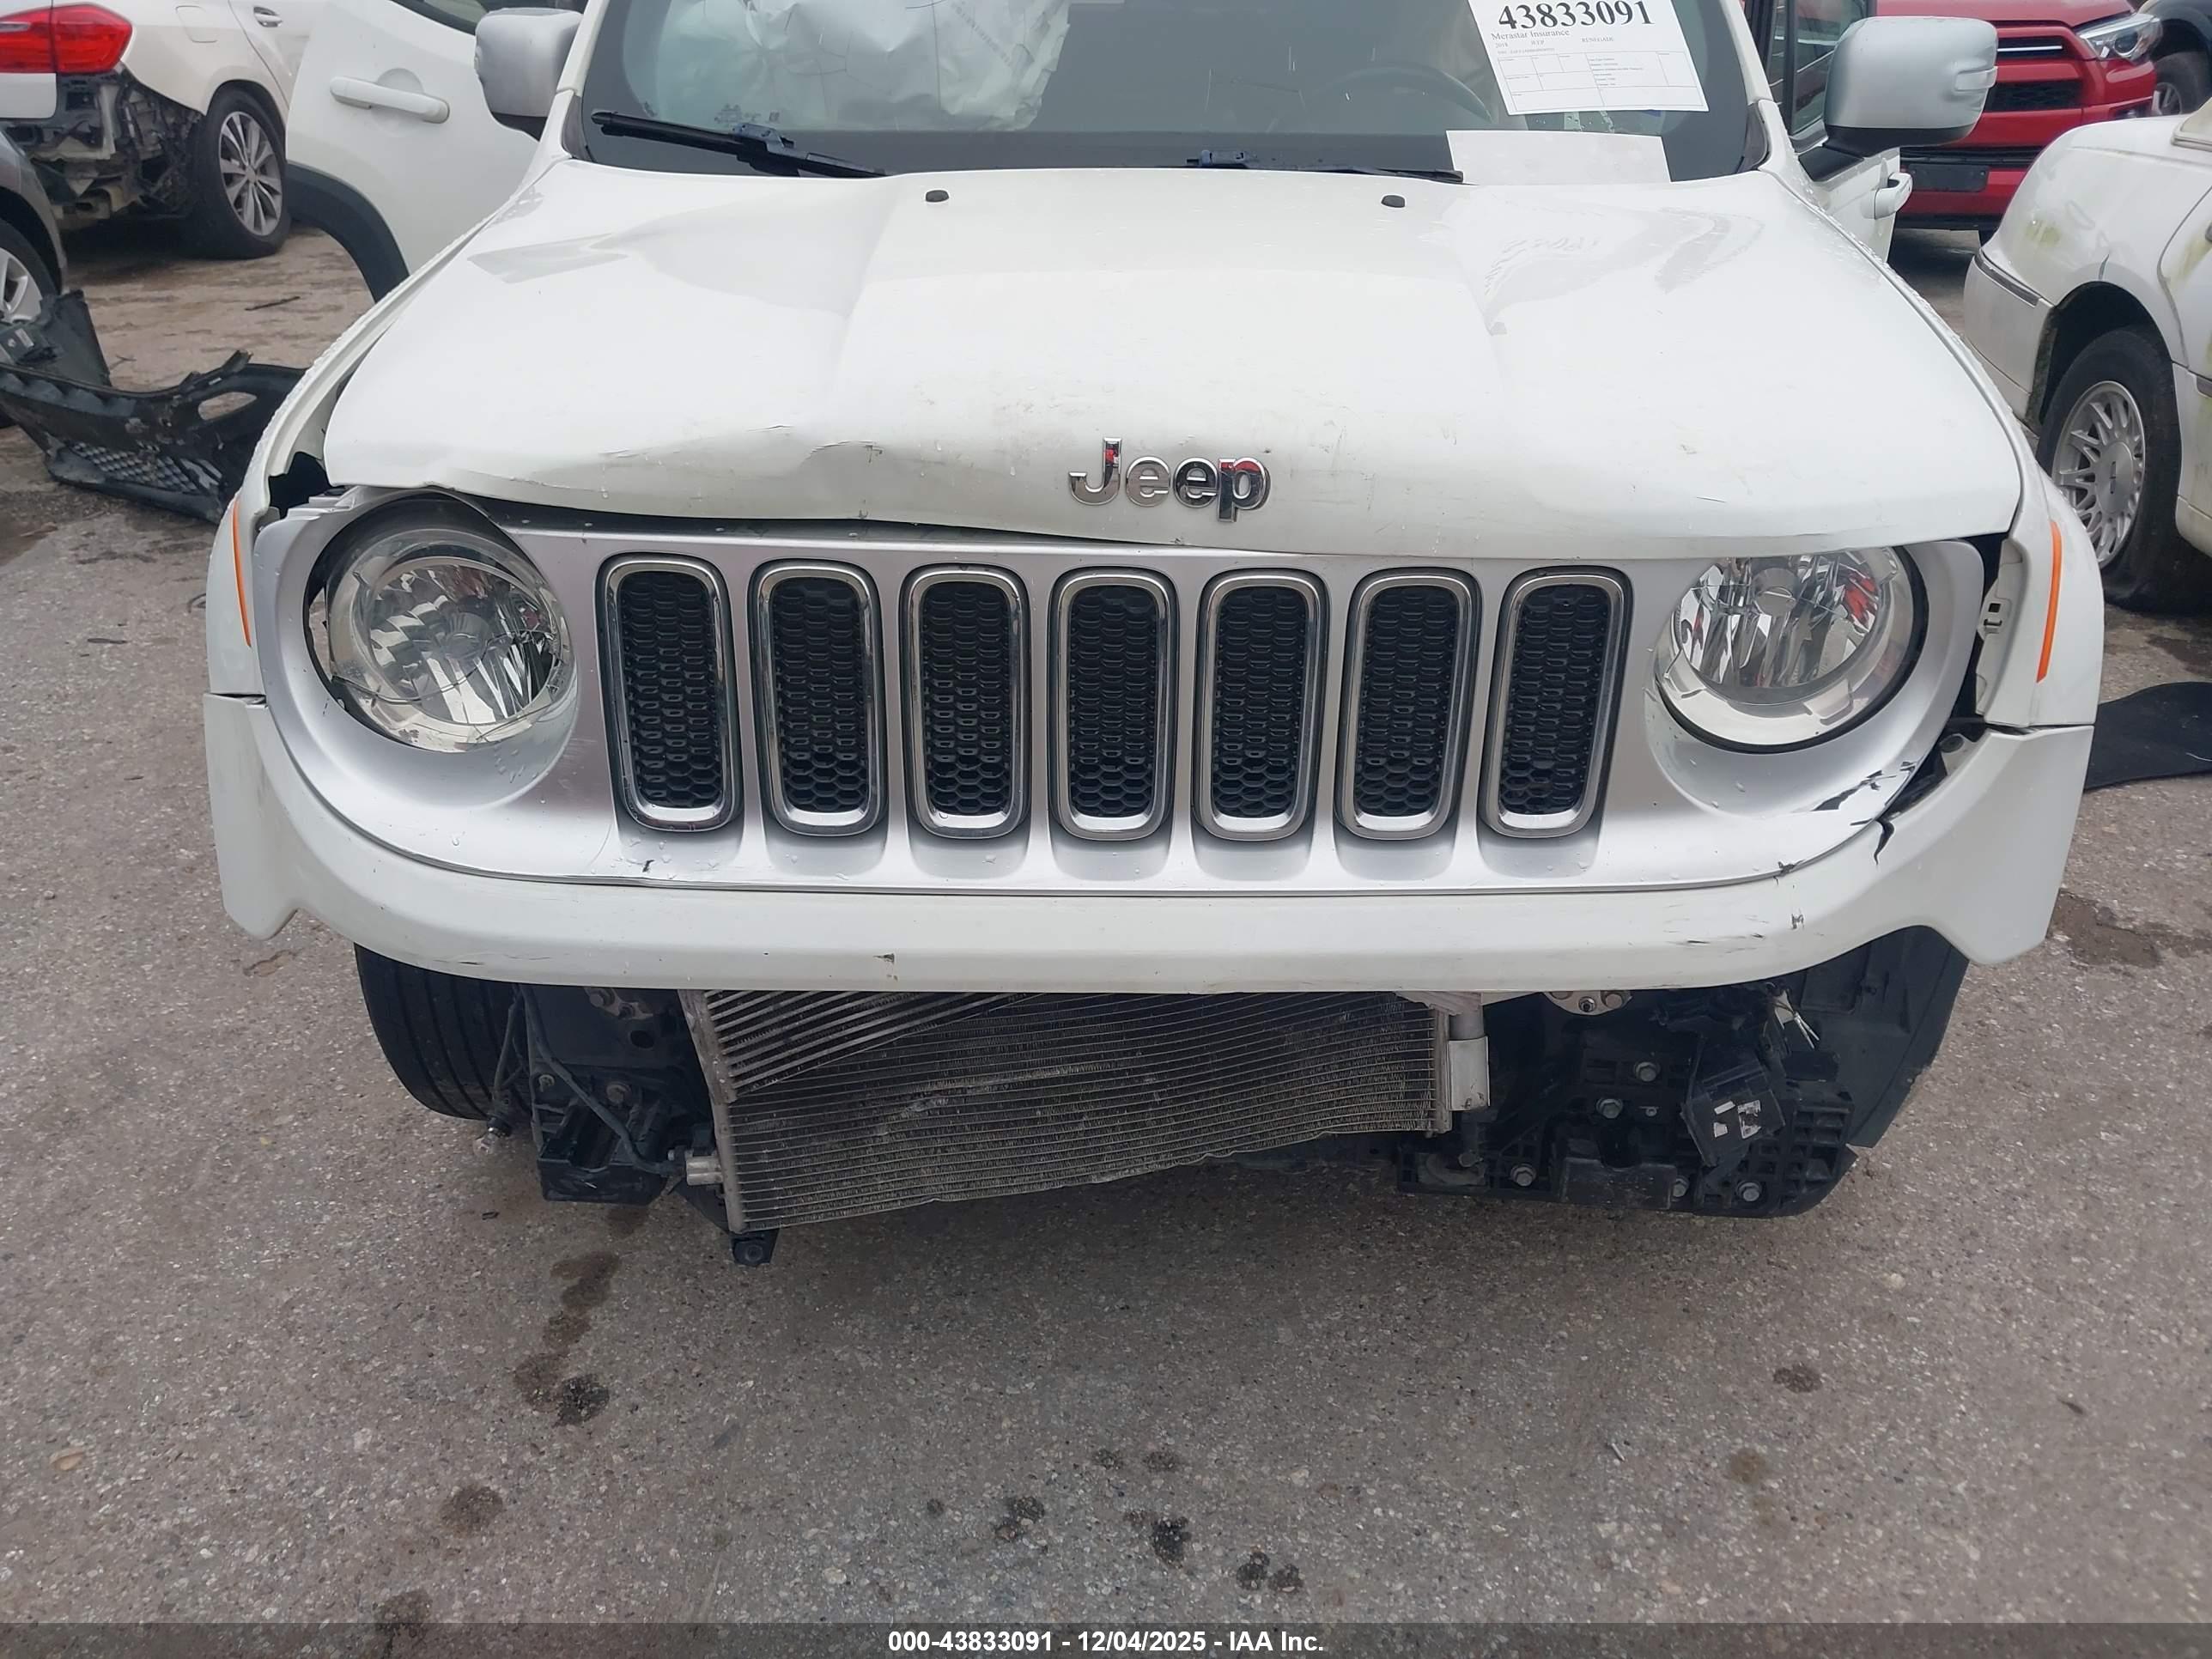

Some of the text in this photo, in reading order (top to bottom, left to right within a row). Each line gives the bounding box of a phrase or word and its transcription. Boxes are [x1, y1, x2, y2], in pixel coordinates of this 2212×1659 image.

[1498, 0, 1656, 29] 43833091
[1491, 29, 1571, 41] Merastar Insurance
[1068, 437, 1271, 523] Jeep
